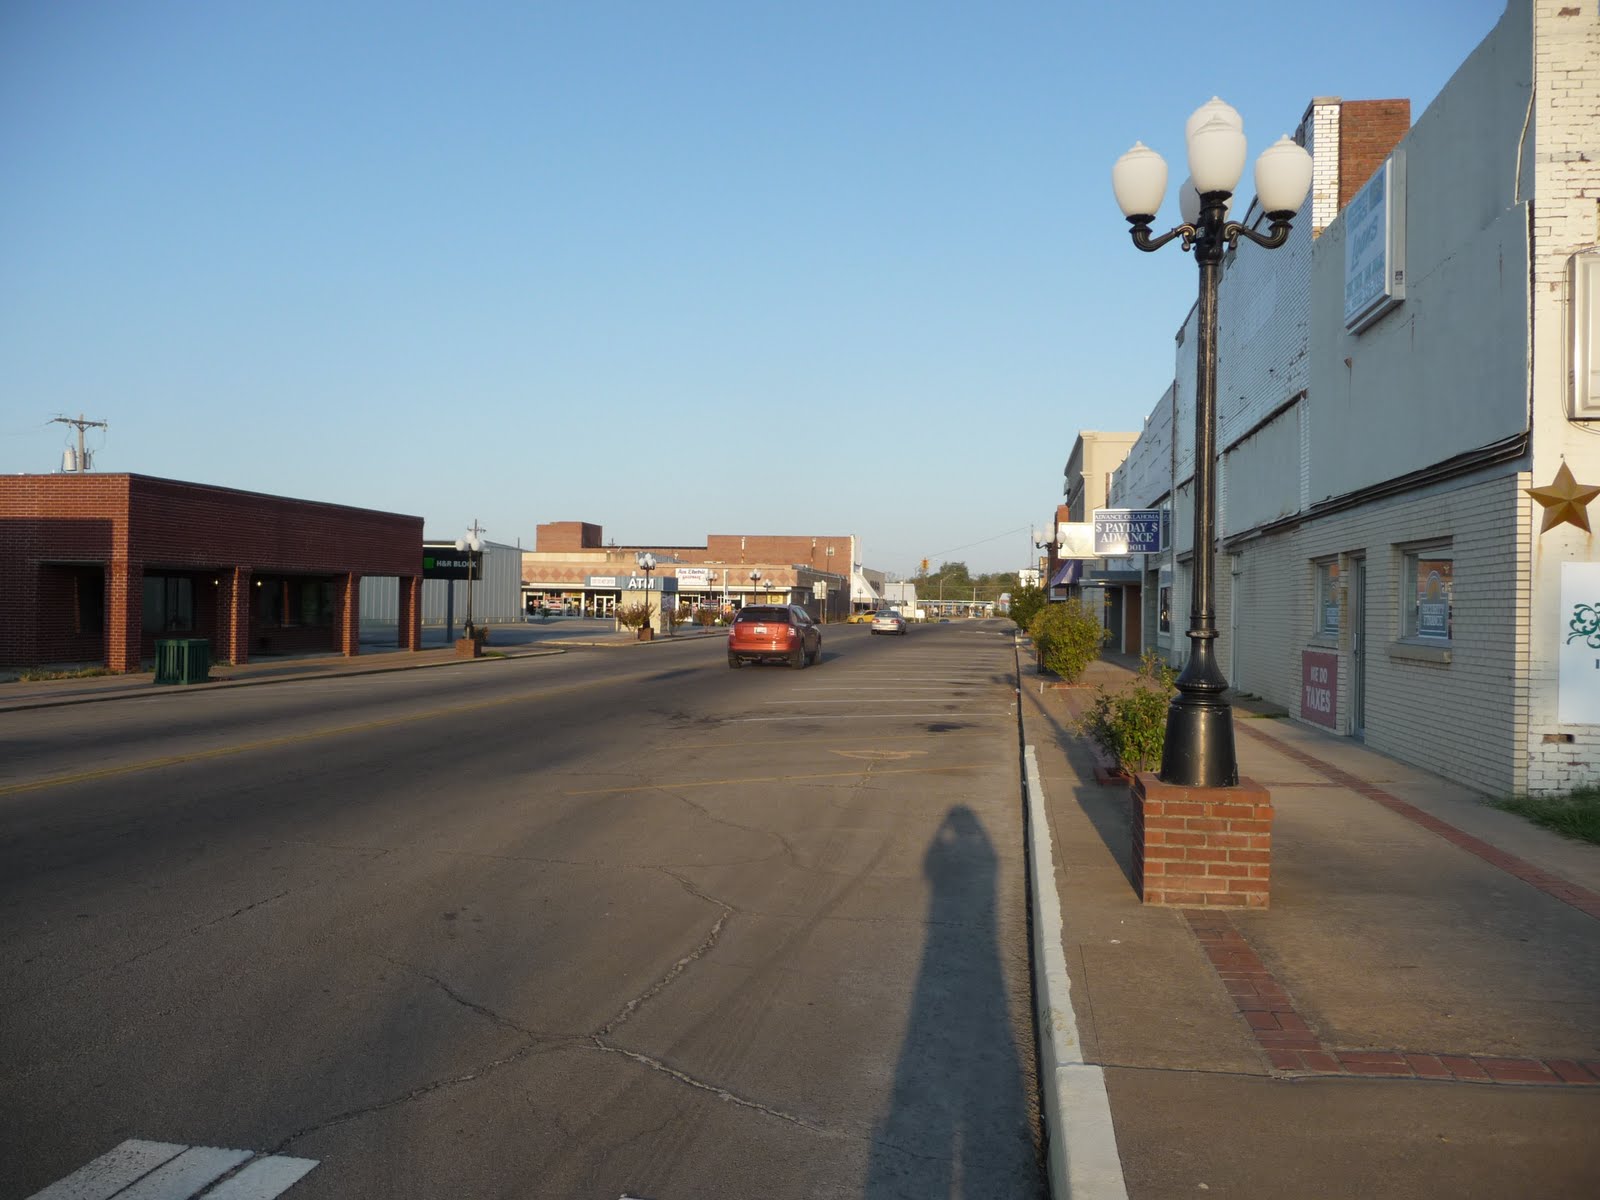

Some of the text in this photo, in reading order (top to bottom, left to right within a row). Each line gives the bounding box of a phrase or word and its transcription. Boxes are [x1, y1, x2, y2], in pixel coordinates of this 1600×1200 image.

[1105, 523, 1147, 533] PAYDAY
[1101, 533, 1153, 543] ADVANCE
[628, 578, 655, 589] ATM
[1311, 666, 1328, 684] WE DO
[1305, 685, 1331, 713] TAXES
